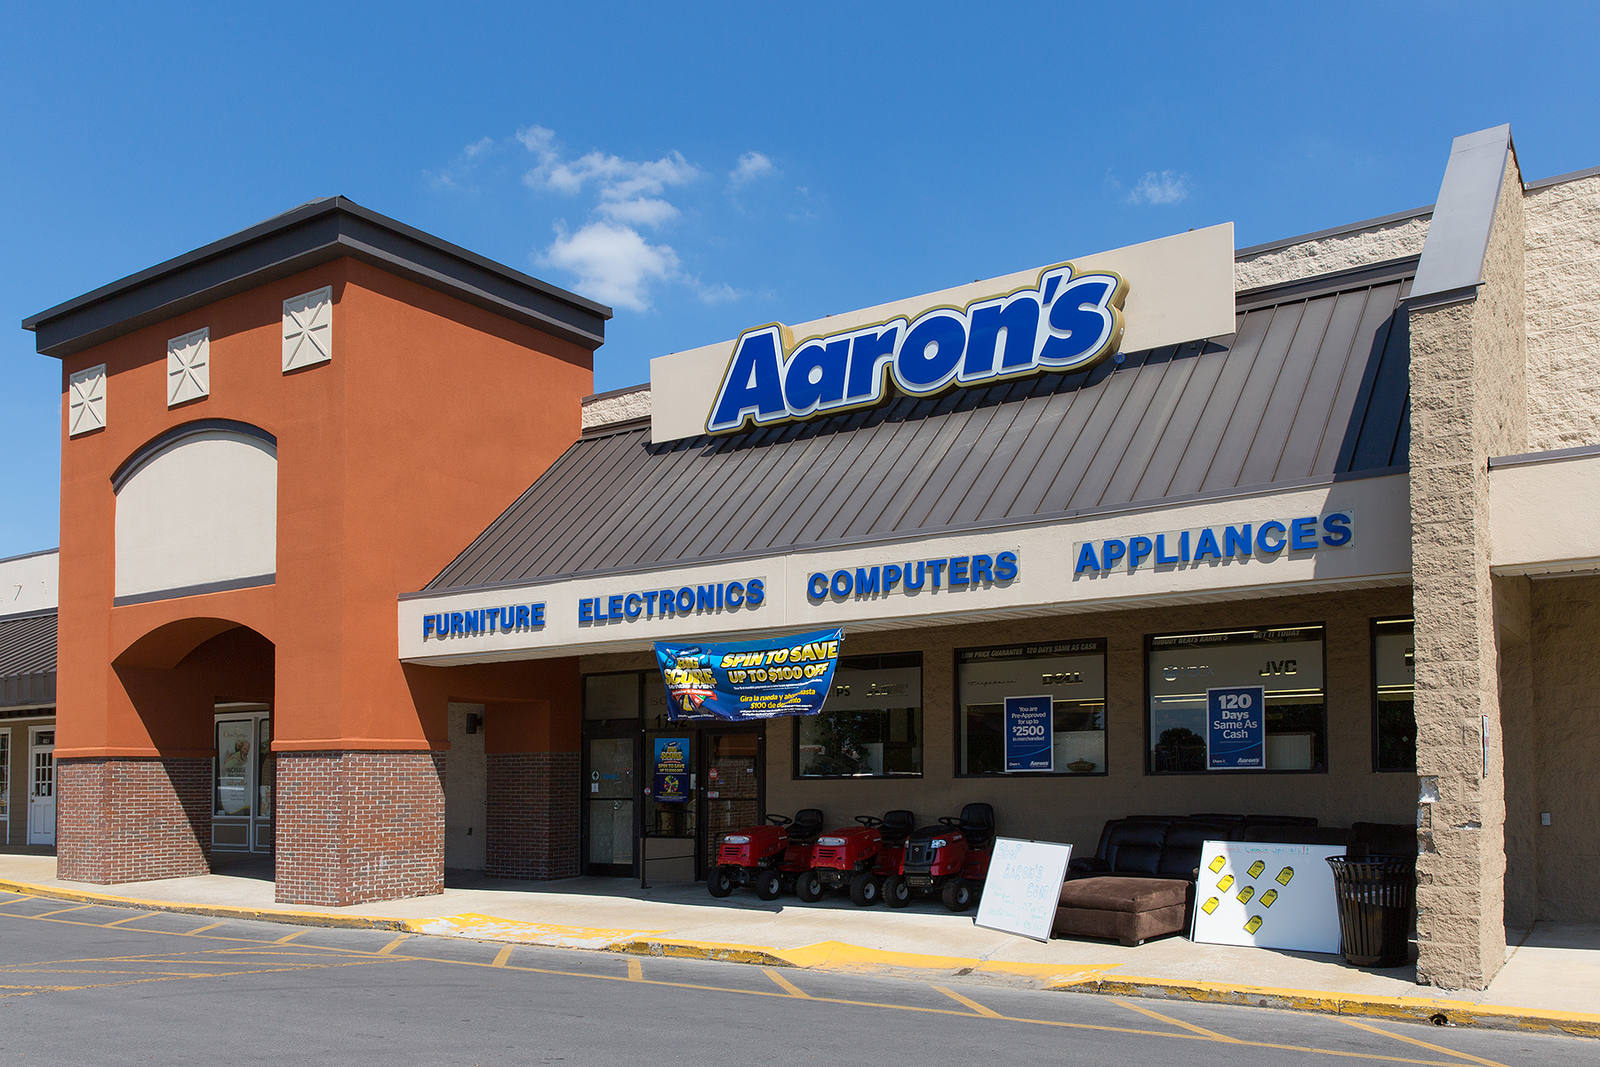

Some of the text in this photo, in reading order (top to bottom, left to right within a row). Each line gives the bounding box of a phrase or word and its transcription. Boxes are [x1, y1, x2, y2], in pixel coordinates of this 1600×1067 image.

[707, 264, 1124, 432] Aaron's
[1073, 513, 1353, 576] APPLIANCES
[807, 550, 1019, 600] COMPUTERS
[578, 578, 765, 624] ELECTRONICS
[423, 602, 546, 638] FURNITURE
[676, 657, 699, 669] BIG
[720, 640, 839, 668] SPIN TO SAVE
[664, 667, 717, 686] SCORE
[728, 661, 830, 684] UP TO $100 OFF
[1259, 660, 1297, 677] JVC
[740, 695, 753, 703] Gira
[753, 694, 759, 702] la
[1218, 694, 1252, 709] 120
[1222, 710, 1249, 720] Days
[1012, 725, 1045, 736] $2500
[1213, 719, 1258, 730] Same As
[1223, 729, 1249, 739] Cash
